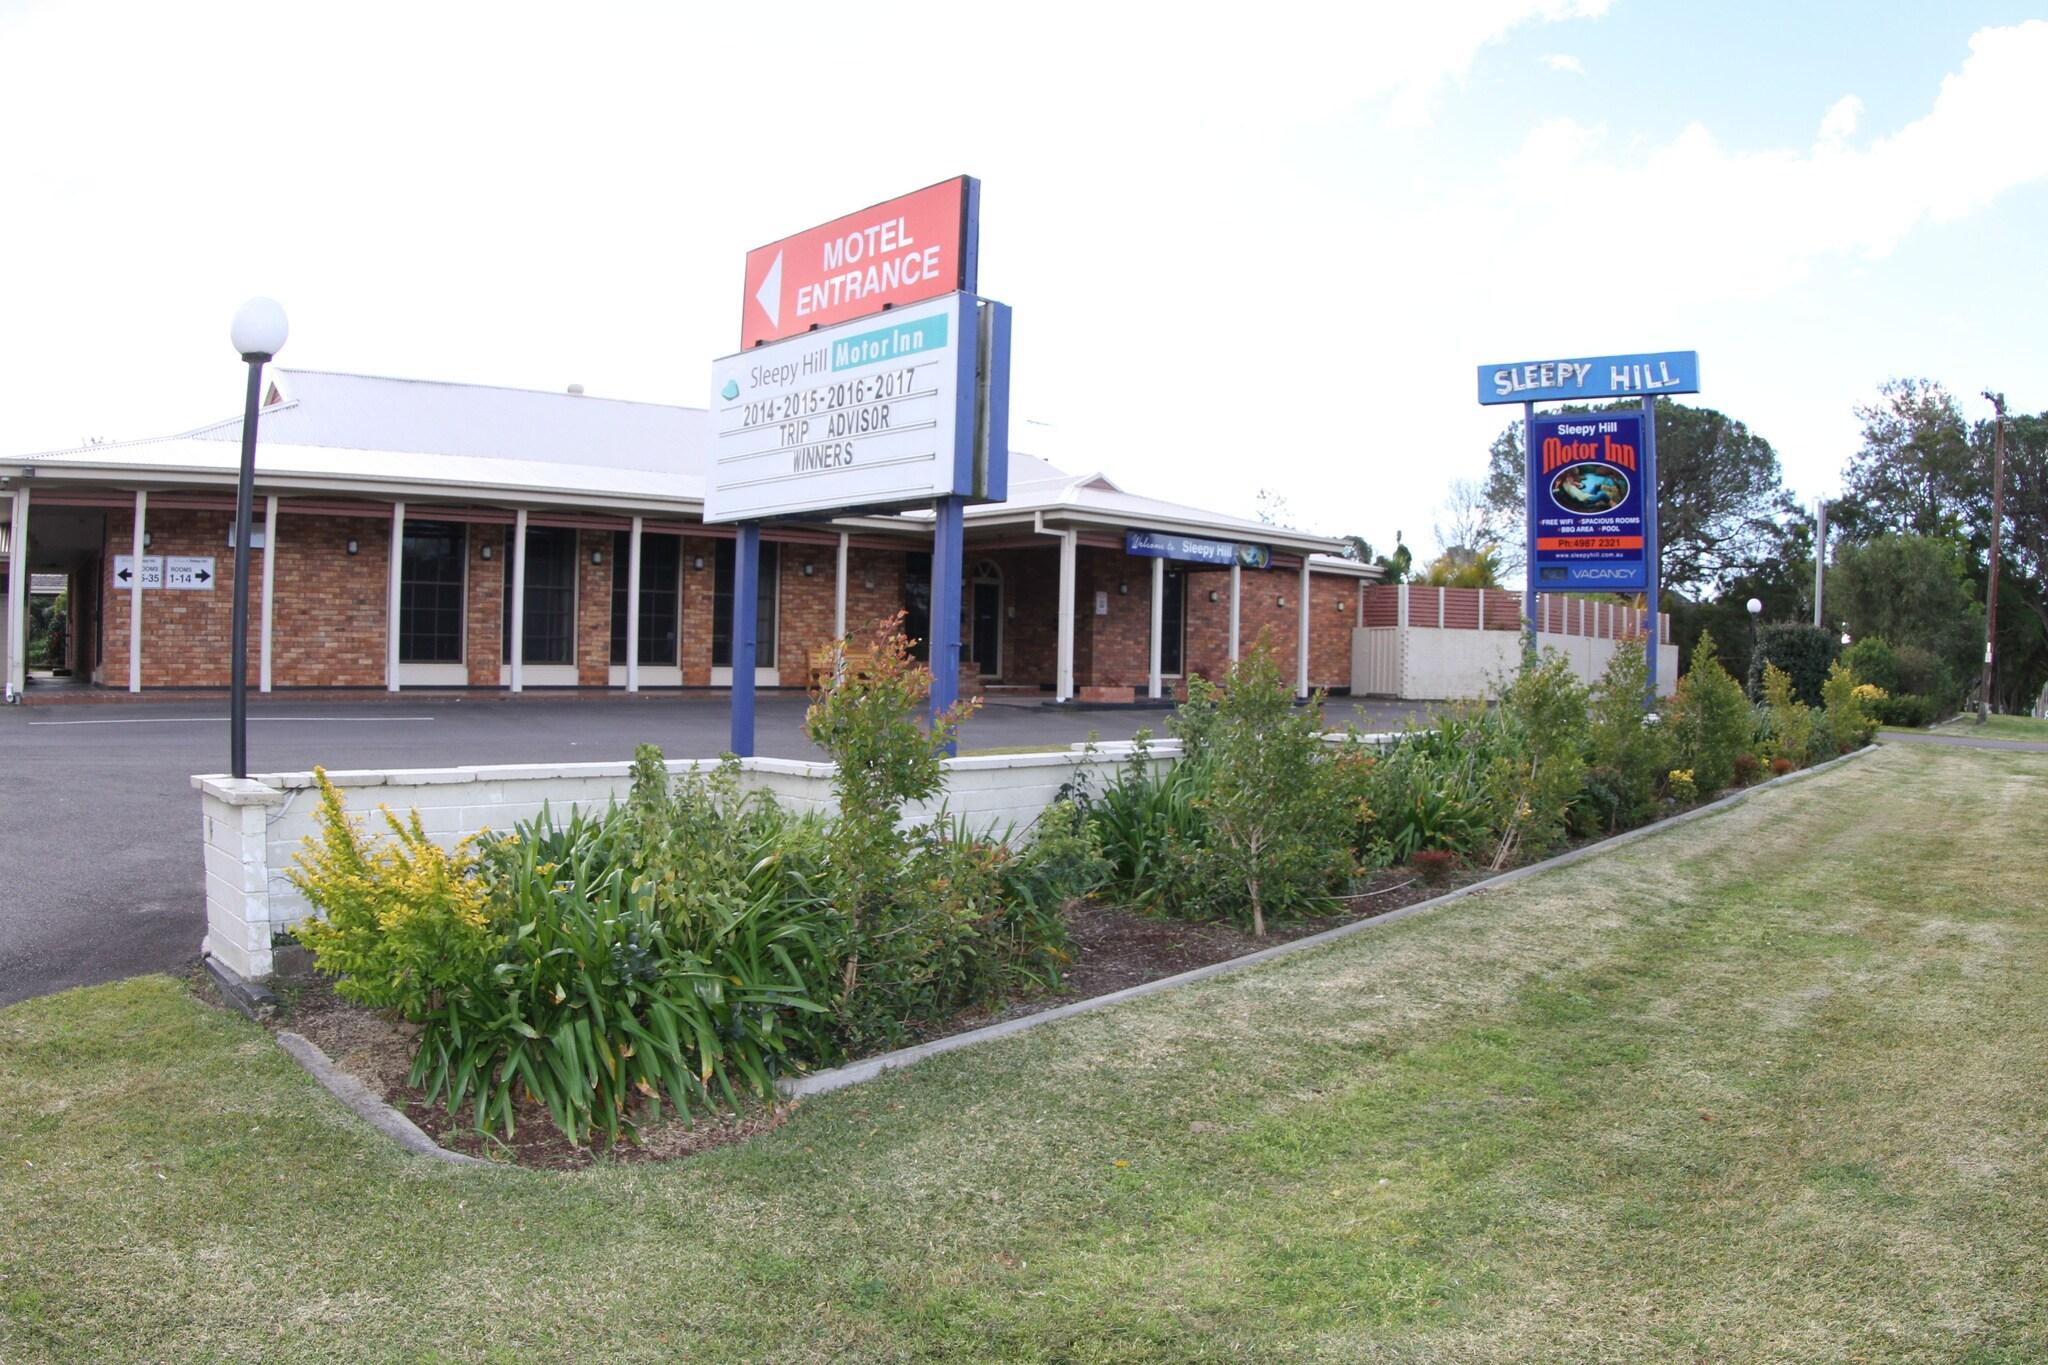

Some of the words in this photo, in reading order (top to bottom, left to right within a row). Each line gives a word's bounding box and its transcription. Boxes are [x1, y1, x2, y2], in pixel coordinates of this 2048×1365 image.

[823, 216, 914, 272] MOTEL
[796, 245, 941, 317] ENTRANCE
[750, 359, 799, 390] Sleepy
[803, 348, 828, 375] Hill
[835, 337, 889, 368] Motor
[893, 329, 924, 352] Inn
[1494, 362, 1592, 395] SLEEPY
[1610, 361, 1680, 391] HILL
[743, 368, 915, 426] 2014-2015-2016-2017
[780, 420, 809, 447] TRIP
[827, 405, 890, 438] ADVISOR
[1557, 424, 1596, 436] Sleepy
[1599, 422, 1618, 434] Hill
[793, 443, 853, 473] WINNERS
[1543, 438, 1599, 475] Motor
[1604, 435, 1636, 472] Inn
[1581, 517, 1614, 525] SPACIOUS
[1182, 540, 1215, 559] Sleepy
[1216, 543, 1232, 558] Hill
[1598, 538, 1620, 547] 2321
[170, 574, 191, 583] 1-14
[1572, 569, 1637, 579] VACANCY
